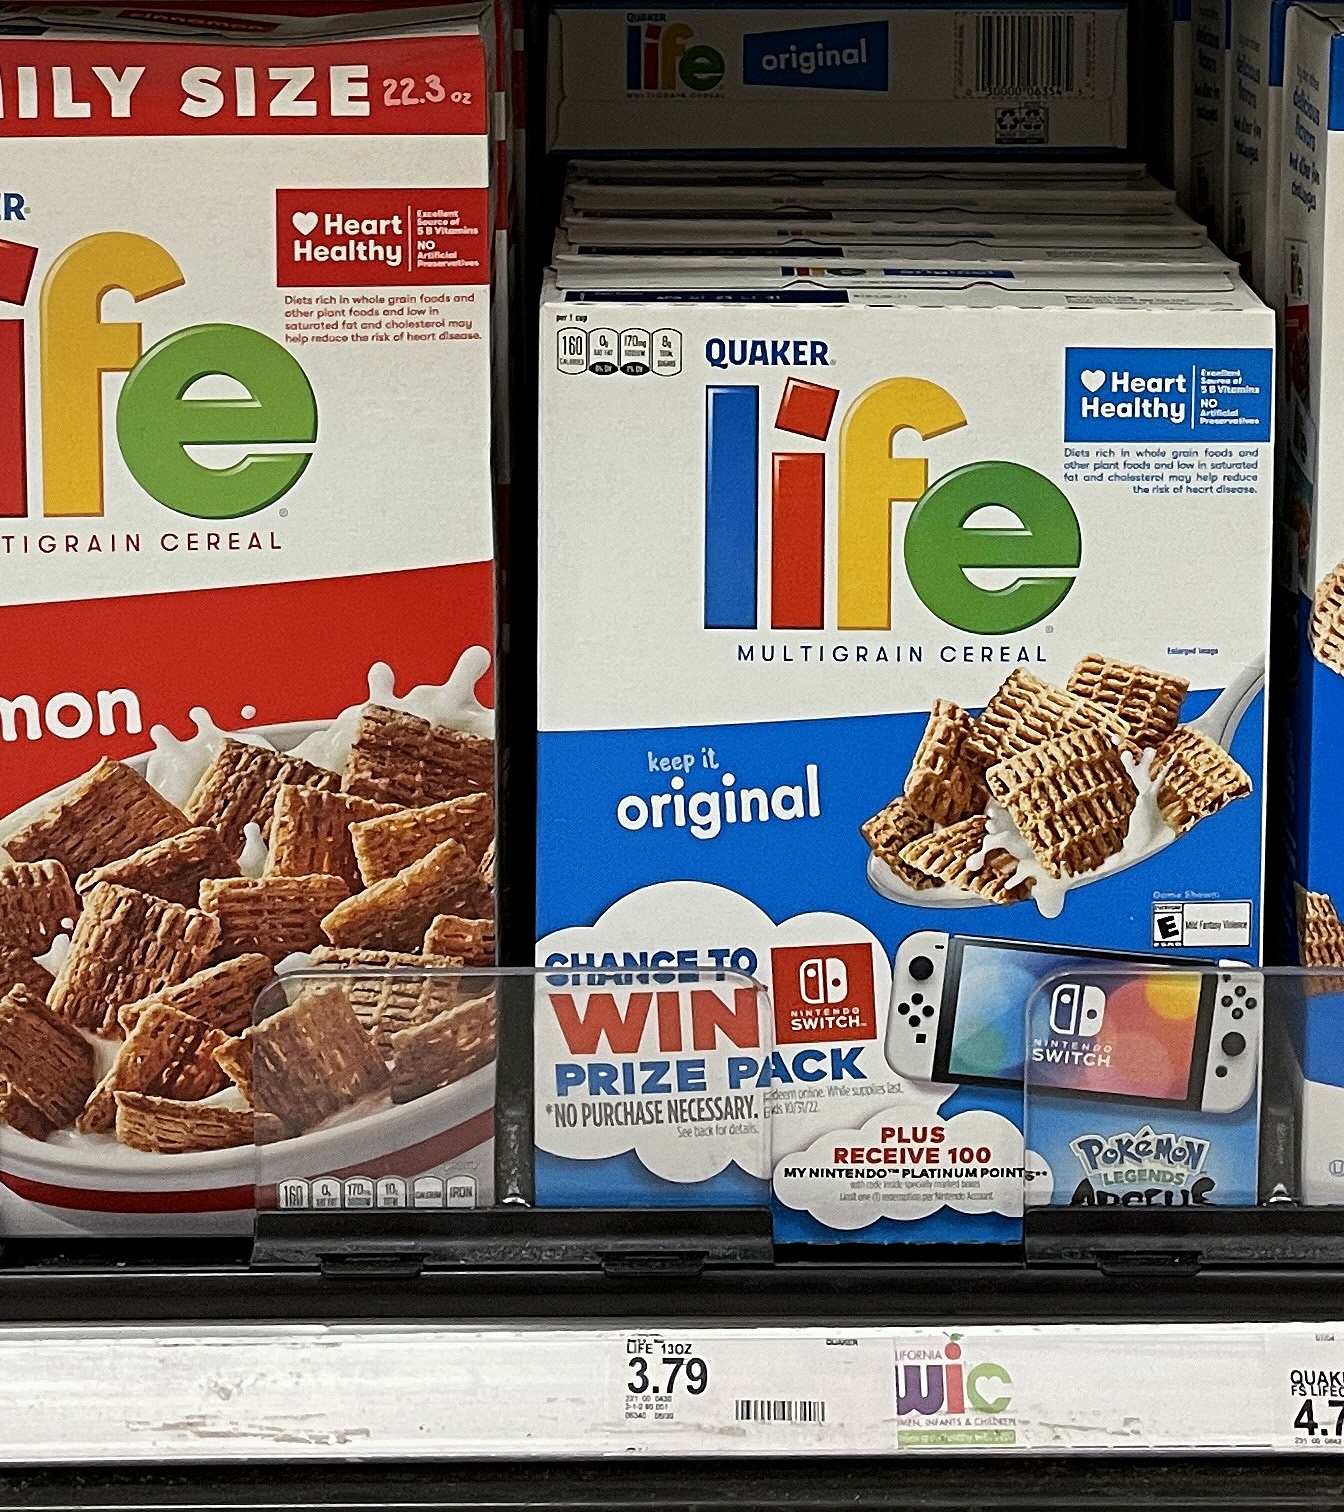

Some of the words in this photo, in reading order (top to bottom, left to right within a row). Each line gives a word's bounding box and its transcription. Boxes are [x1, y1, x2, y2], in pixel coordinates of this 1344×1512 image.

[762, 38, 867, 73] original
[181, 65, 370, 118] SIZE
[384, 76, 445, 108] 22.3
[451, 92, 472, 105] oz
[324, 214, 402, 237] Heart
[294, 239, 402, 266] Healthy
[706, 338, 829, 370] QUAKER
[1112, 371, 1186, 394] Heart
[1081, 397, 1185, 422] Healthy
[704, 377, 1081, 634] life
[161, 532, 281, 551] CEREAL
[738, 646, 922, 664] MULTIGRAIN
[942, 645, 1046, 663] CEREAL
[647, 750, 695, 775] keep
[703, 747, 718, 769] it
[617, 765, 820, 839] original
[548, 987, 760, 1055] WIN
[791, 1016, 860, 1030] SWITCH
[556, 1055, 709, 1097] PRIZE
[729, 1047, 867, 1087] PACK
[881, 1127, 945, 1144] PLUS
[834, 1147, 938, 1164] RECEIVE
[948, 1147, 990, 1164] 100
[627, 1343, 653, 1354] LIFE
[661, 1343, 692, 1354] 13OZ
[628, 1358, 708, 1394] 3.79
[896, 1342, 1011, 1415] wic
[1291, 1386, 1307, 1396] FS
